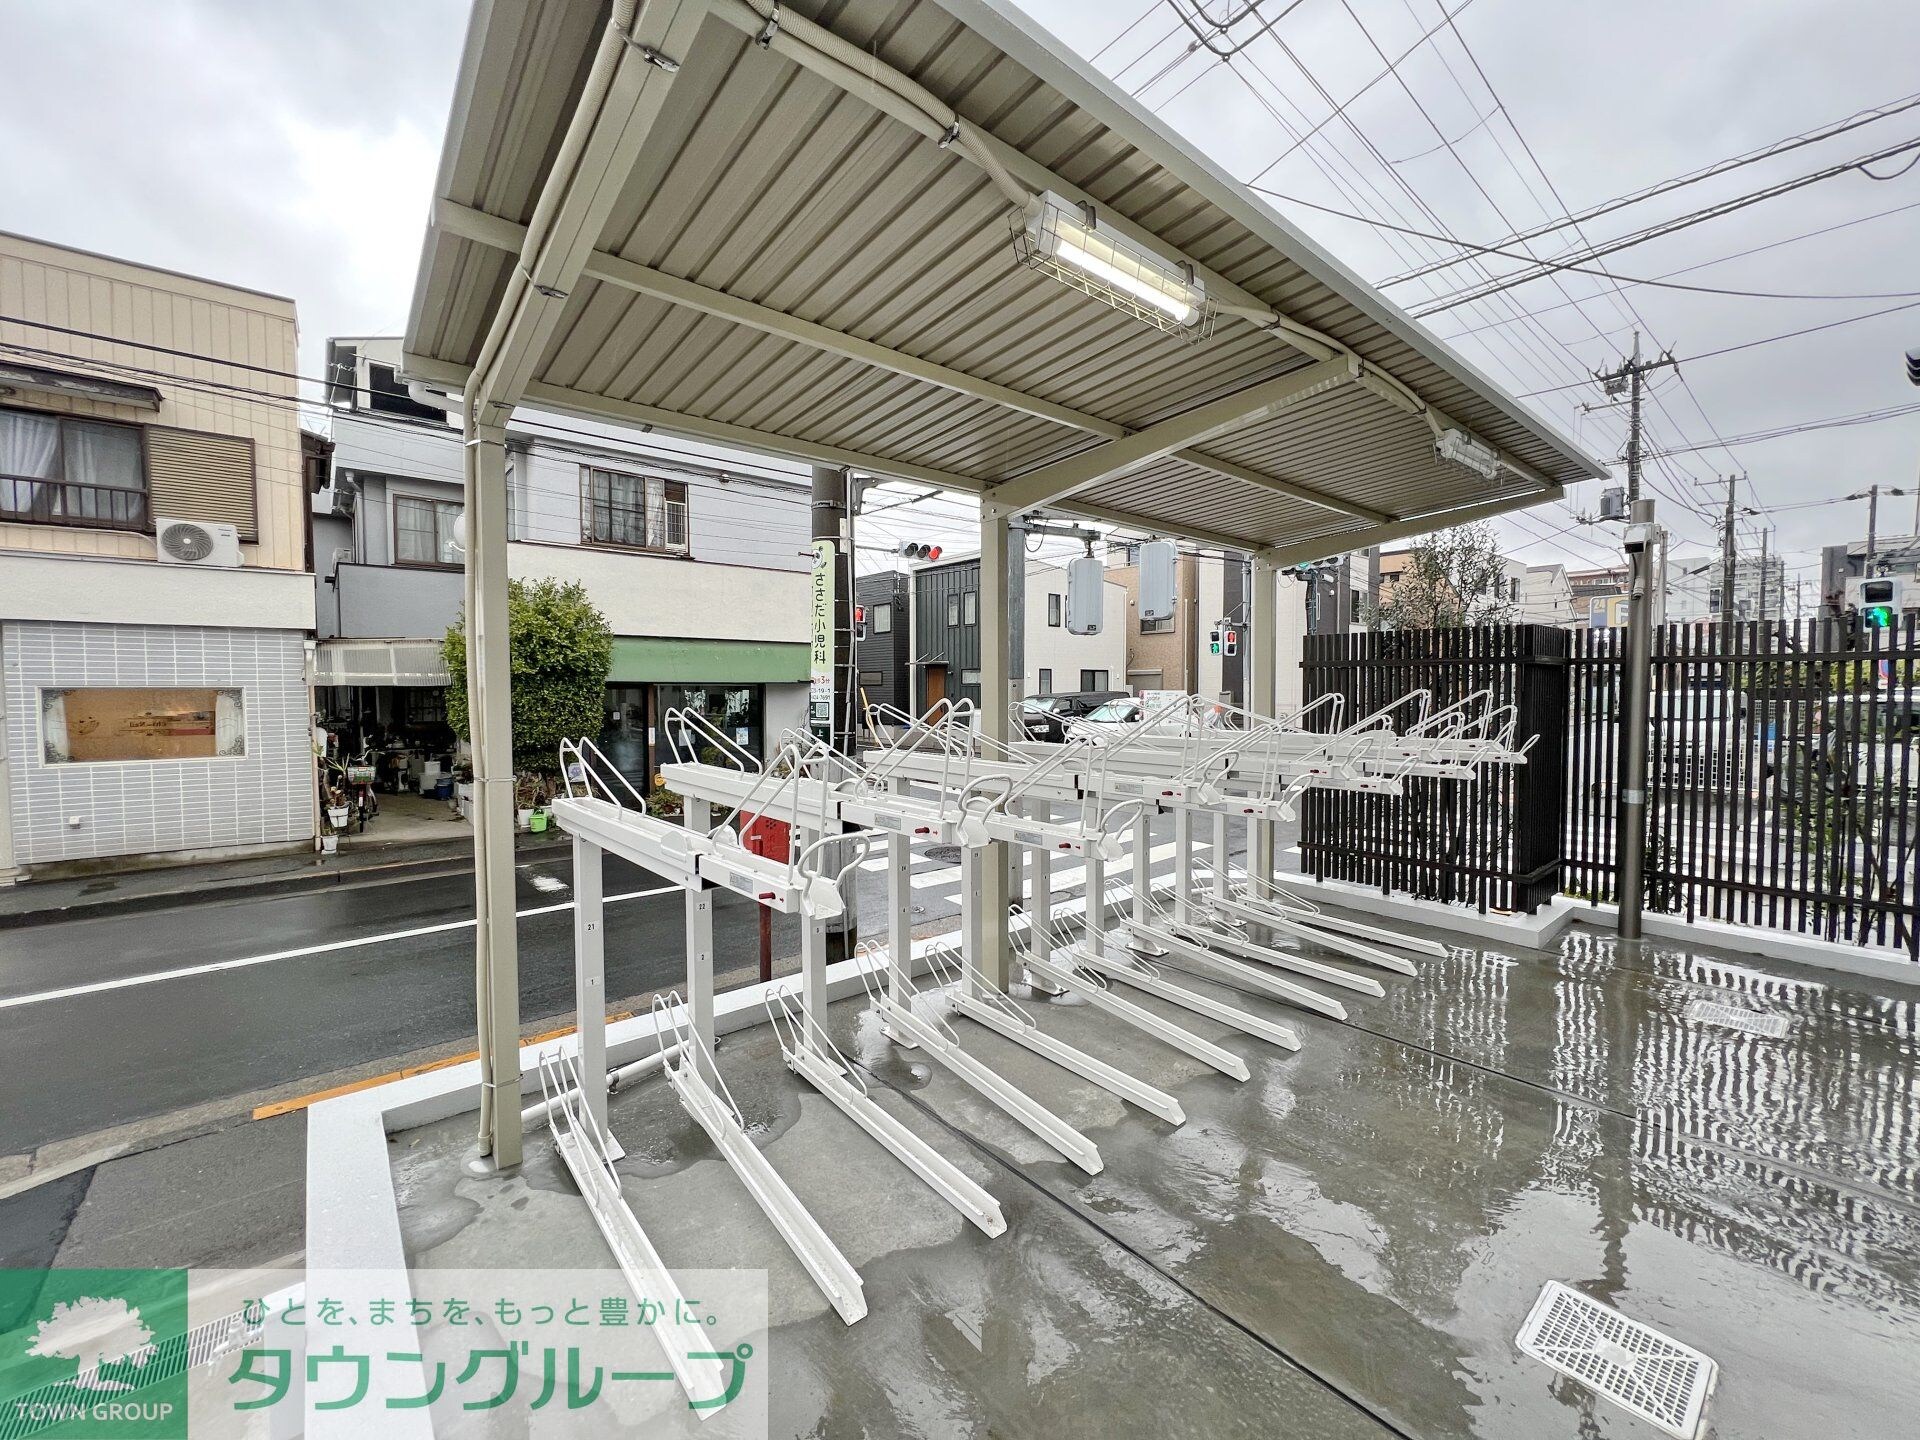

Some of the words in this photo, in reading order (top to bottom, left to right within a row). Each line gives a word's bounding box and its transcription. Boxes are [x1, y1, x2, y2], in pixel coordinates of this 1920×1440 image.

[814, 572, 826, 665] ささだ小児科
[587, 923, 595, 931] 21
